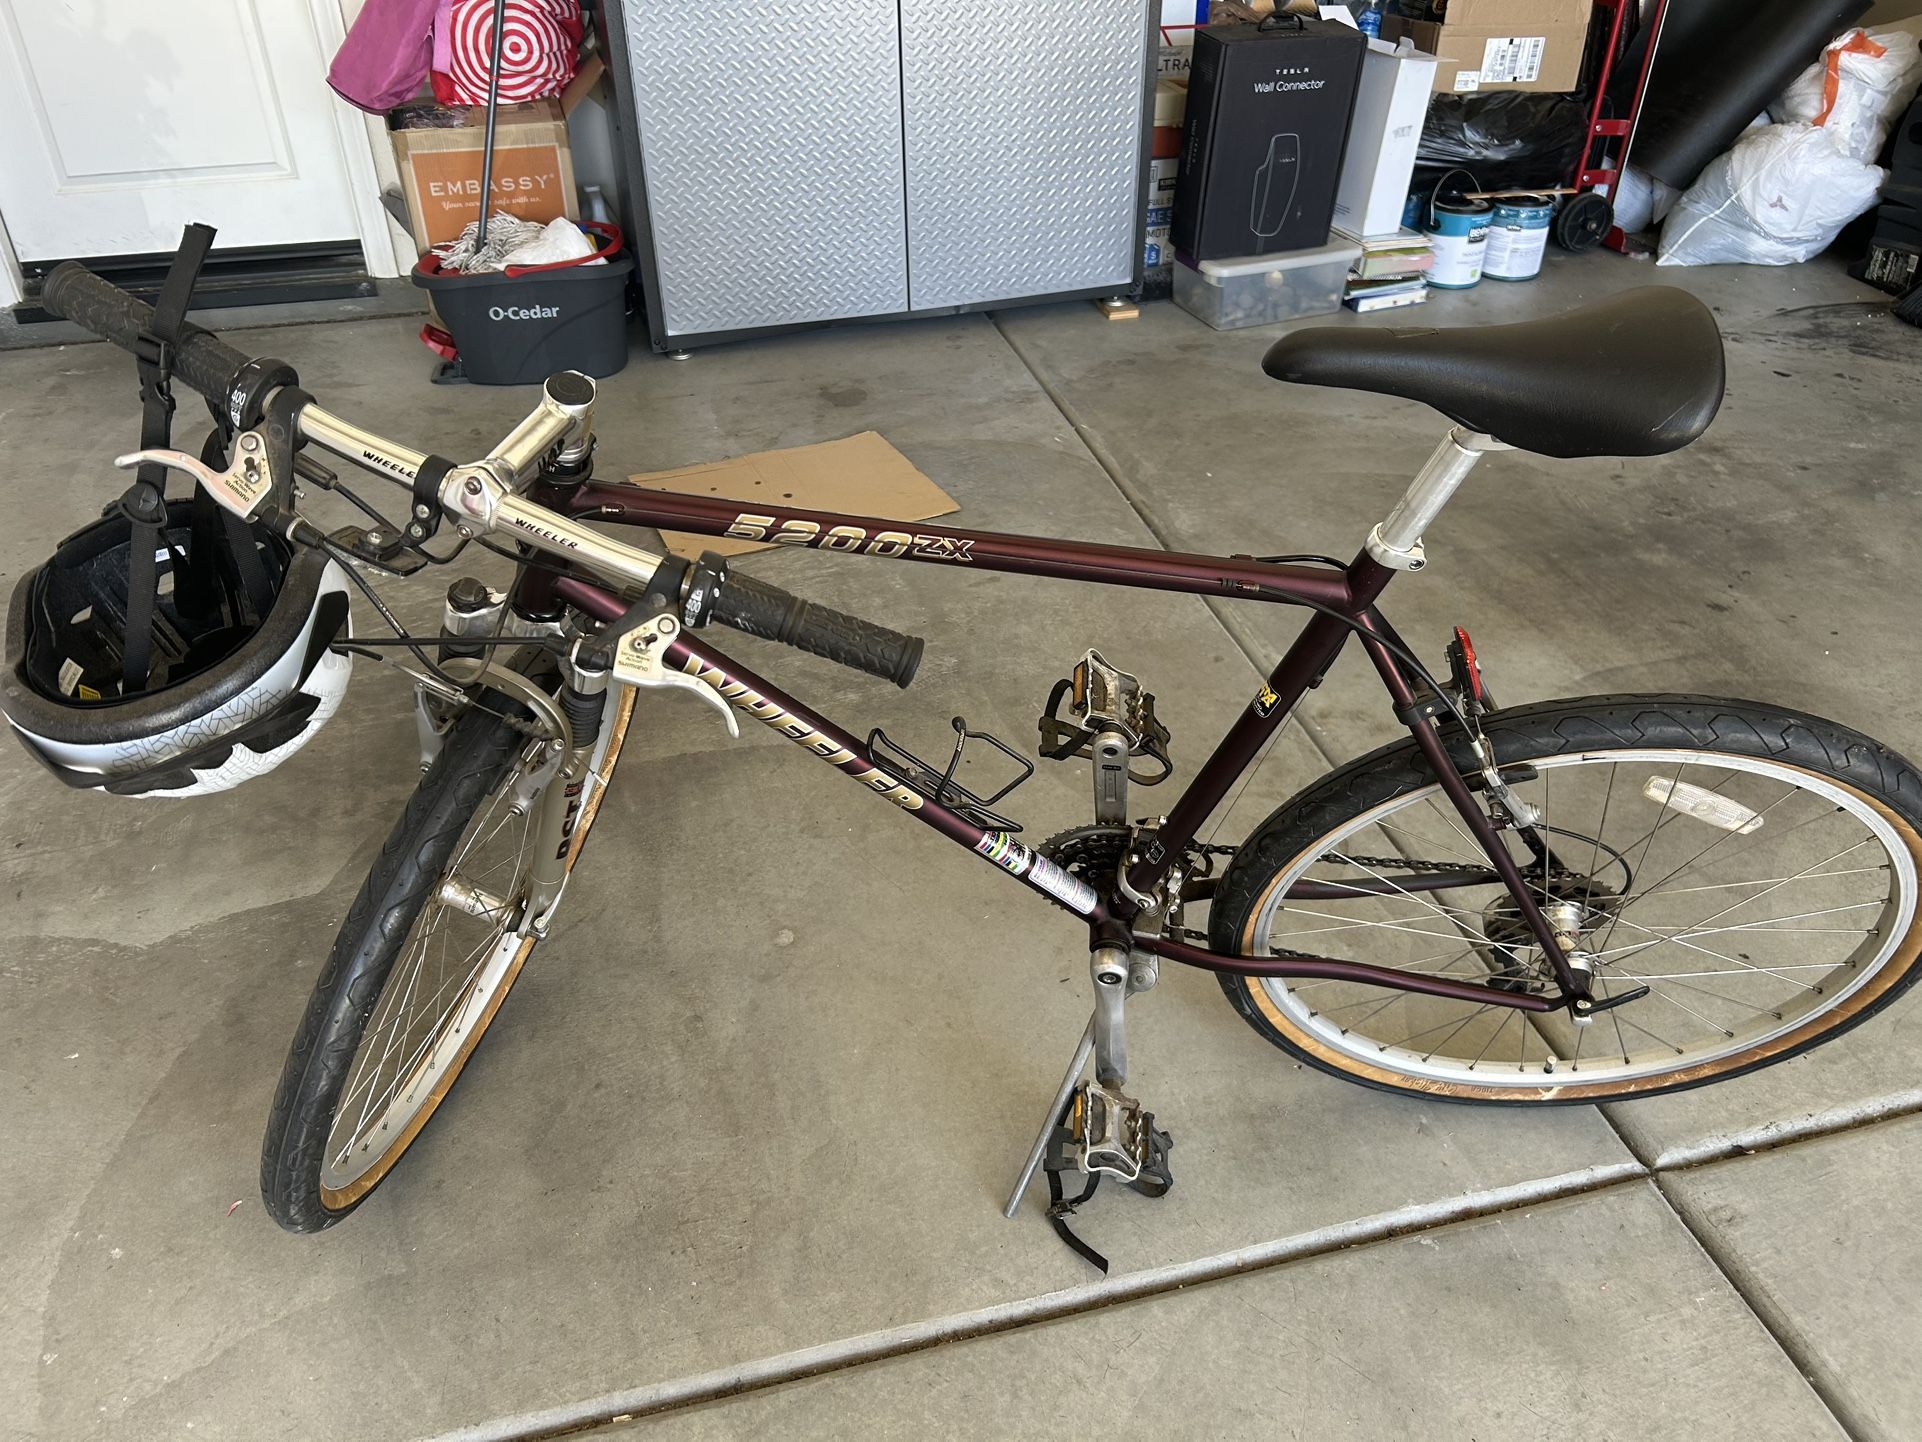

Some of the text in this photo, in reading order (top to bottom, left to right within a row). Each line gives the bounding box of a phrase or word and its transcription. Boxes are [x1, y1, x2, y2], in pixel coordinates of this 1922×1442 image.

[1157, 58, 1192, 71] TRA
[1275, 67, 1309, 75] TESLA
[1254, 79, 1325, 93] Wall Connector
[429, 174, 548, 196] EMBASSY
[488, 304, 560, 321] O-Cedar
[231, 389, 247, 406] 400
[362, 450, 417, 479] WHEELE
[515, 517, 578, 550] WHEELER
[685, 598, 702, 613] 400
